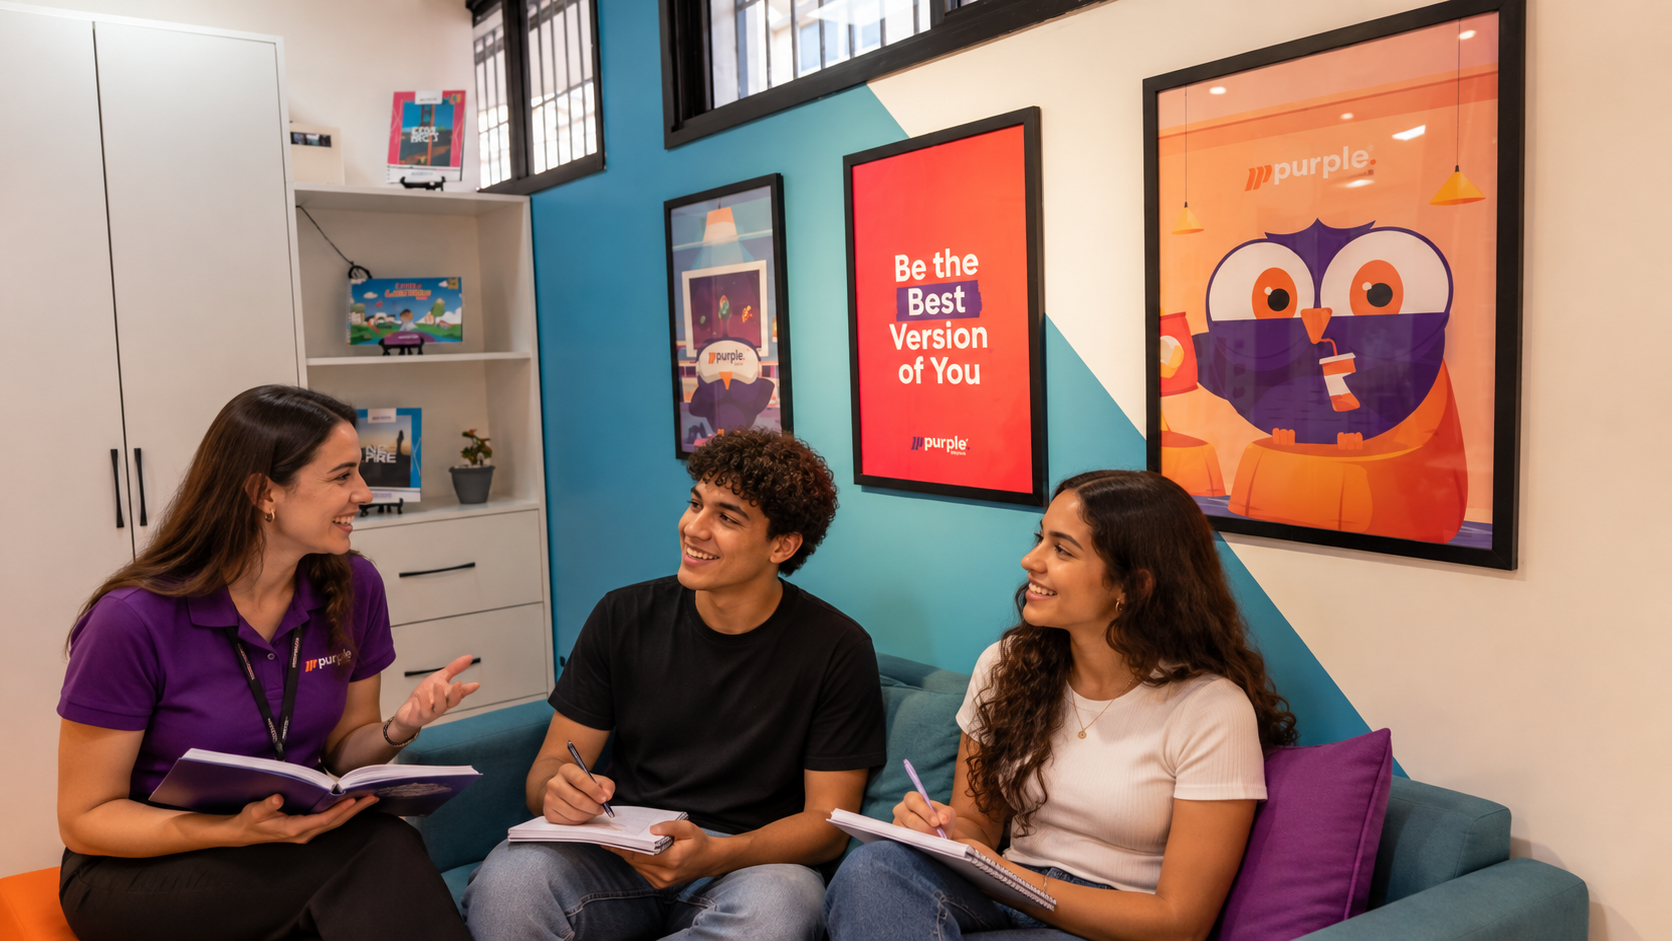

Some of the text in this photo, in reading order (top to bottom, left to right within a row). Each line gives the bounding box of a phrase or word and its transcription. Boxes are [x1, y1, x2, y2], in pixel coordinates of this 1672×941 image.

[895, 248, 979, 282] Be the
[908, 285, 966, 316] Best
[889, 321, 987, 350] Version
[898, 356, 980, 385] of You
